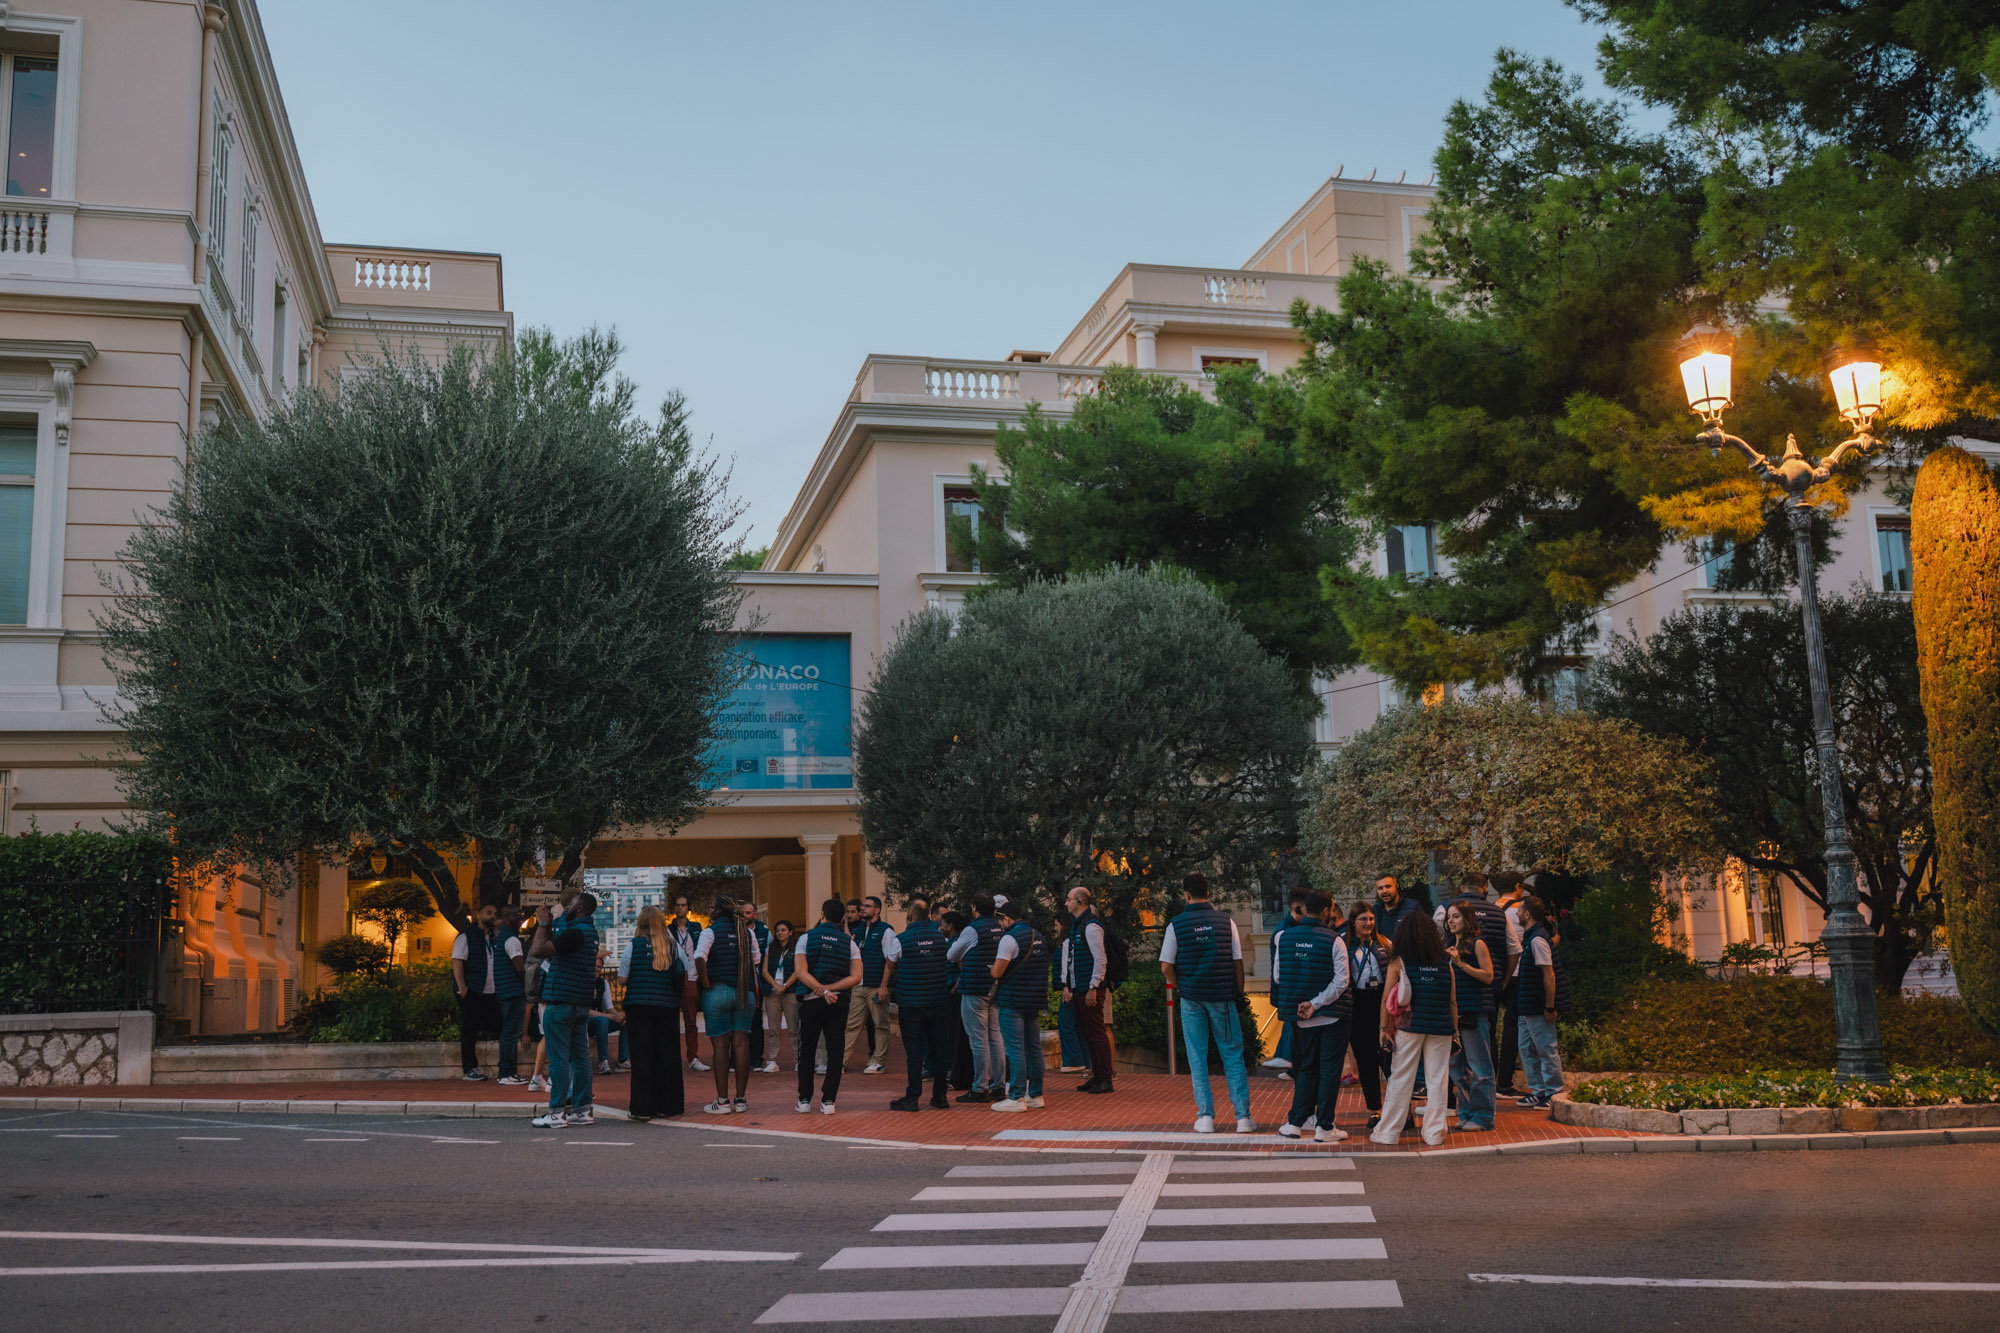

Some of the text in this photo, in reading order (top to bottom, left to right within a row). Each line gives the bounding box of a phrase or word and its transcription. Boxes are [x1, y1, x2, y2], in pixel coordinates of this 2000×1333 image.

[755, 682, 768, 690] de
[770, 682, 820, 691] L'EUROPE
[711, 711, 807, 725] rganisation efficace,
[711, 728, 780, 741] ontemporains.
